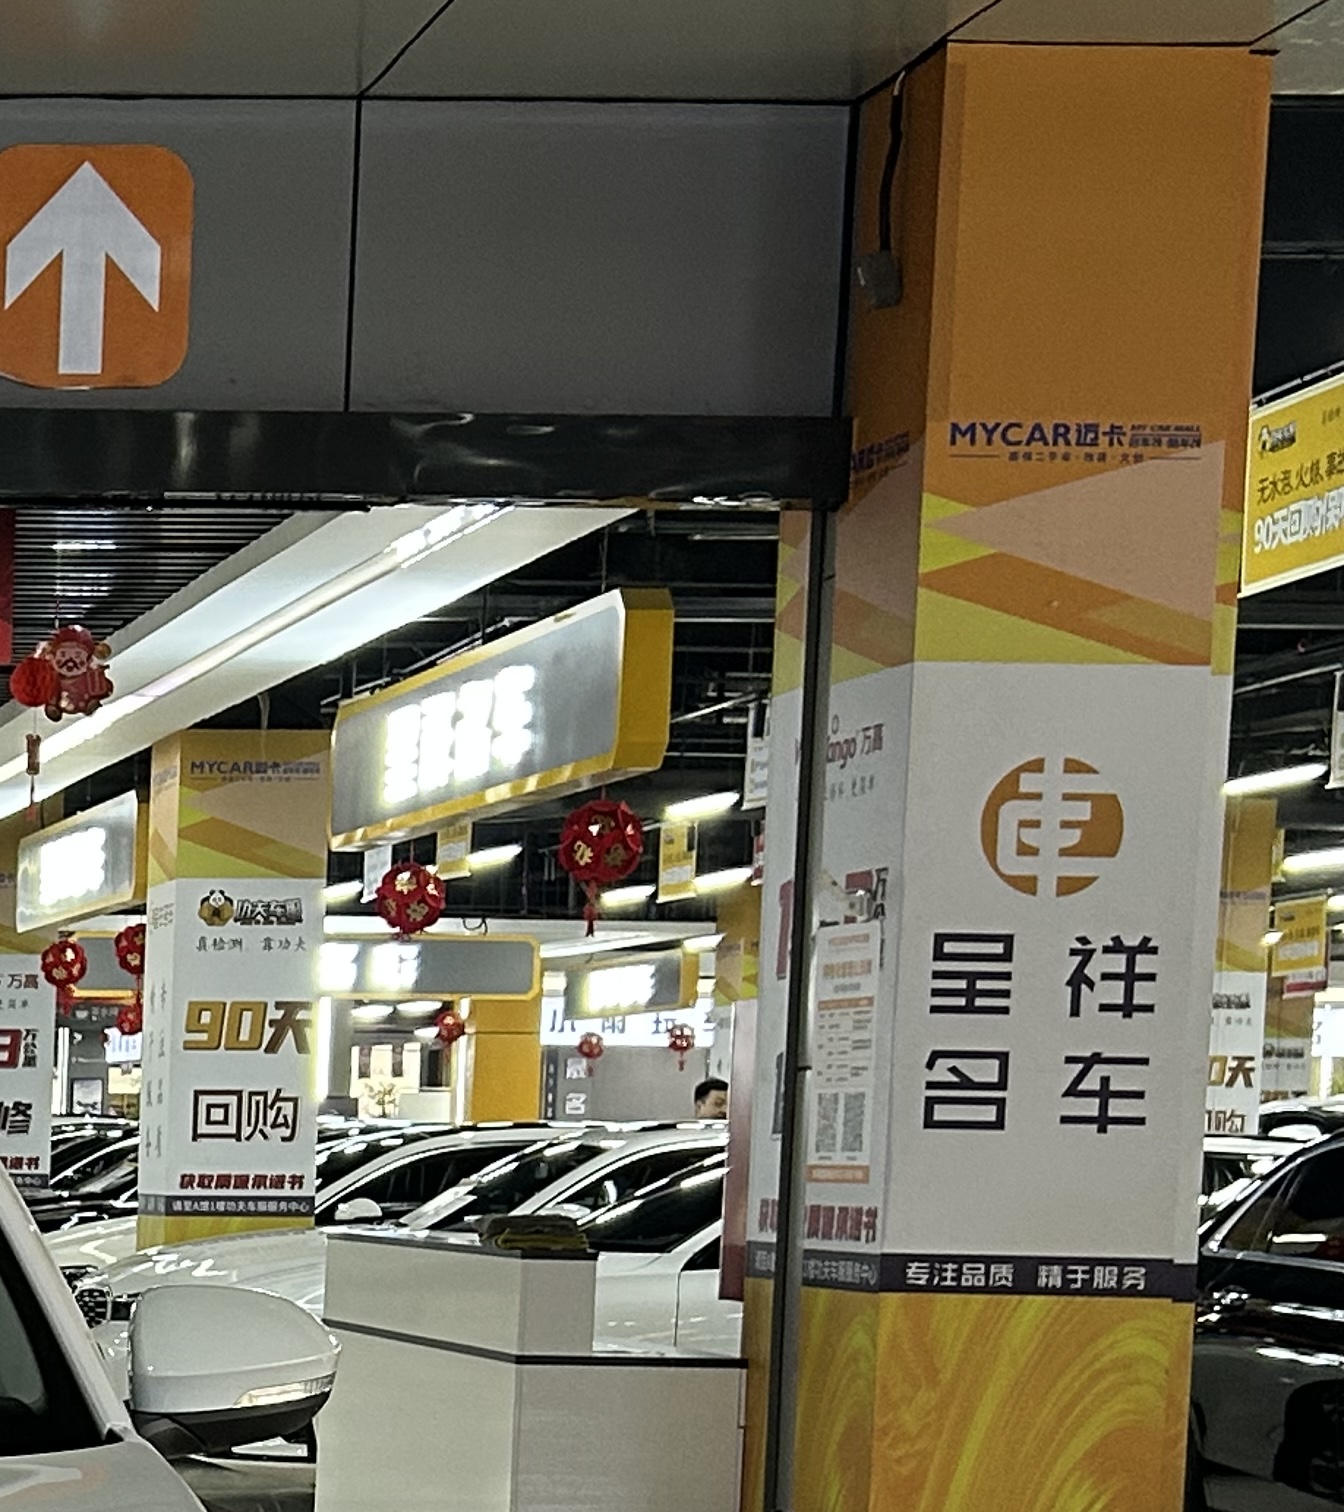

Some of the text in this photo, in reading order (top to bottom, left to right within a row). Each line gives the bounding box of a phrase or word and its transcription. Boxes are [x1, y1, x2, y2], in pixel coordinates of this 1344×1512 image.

[929, 932, 1159, 1018] 呈祥
[182, 1001, 312, 1054] 90天
[192, 1087, 300, 1142] 回购
[923, 1049, 1150, 1134] 名车
[905, 1262, 1147, 1291] 专注品质 精于服务
